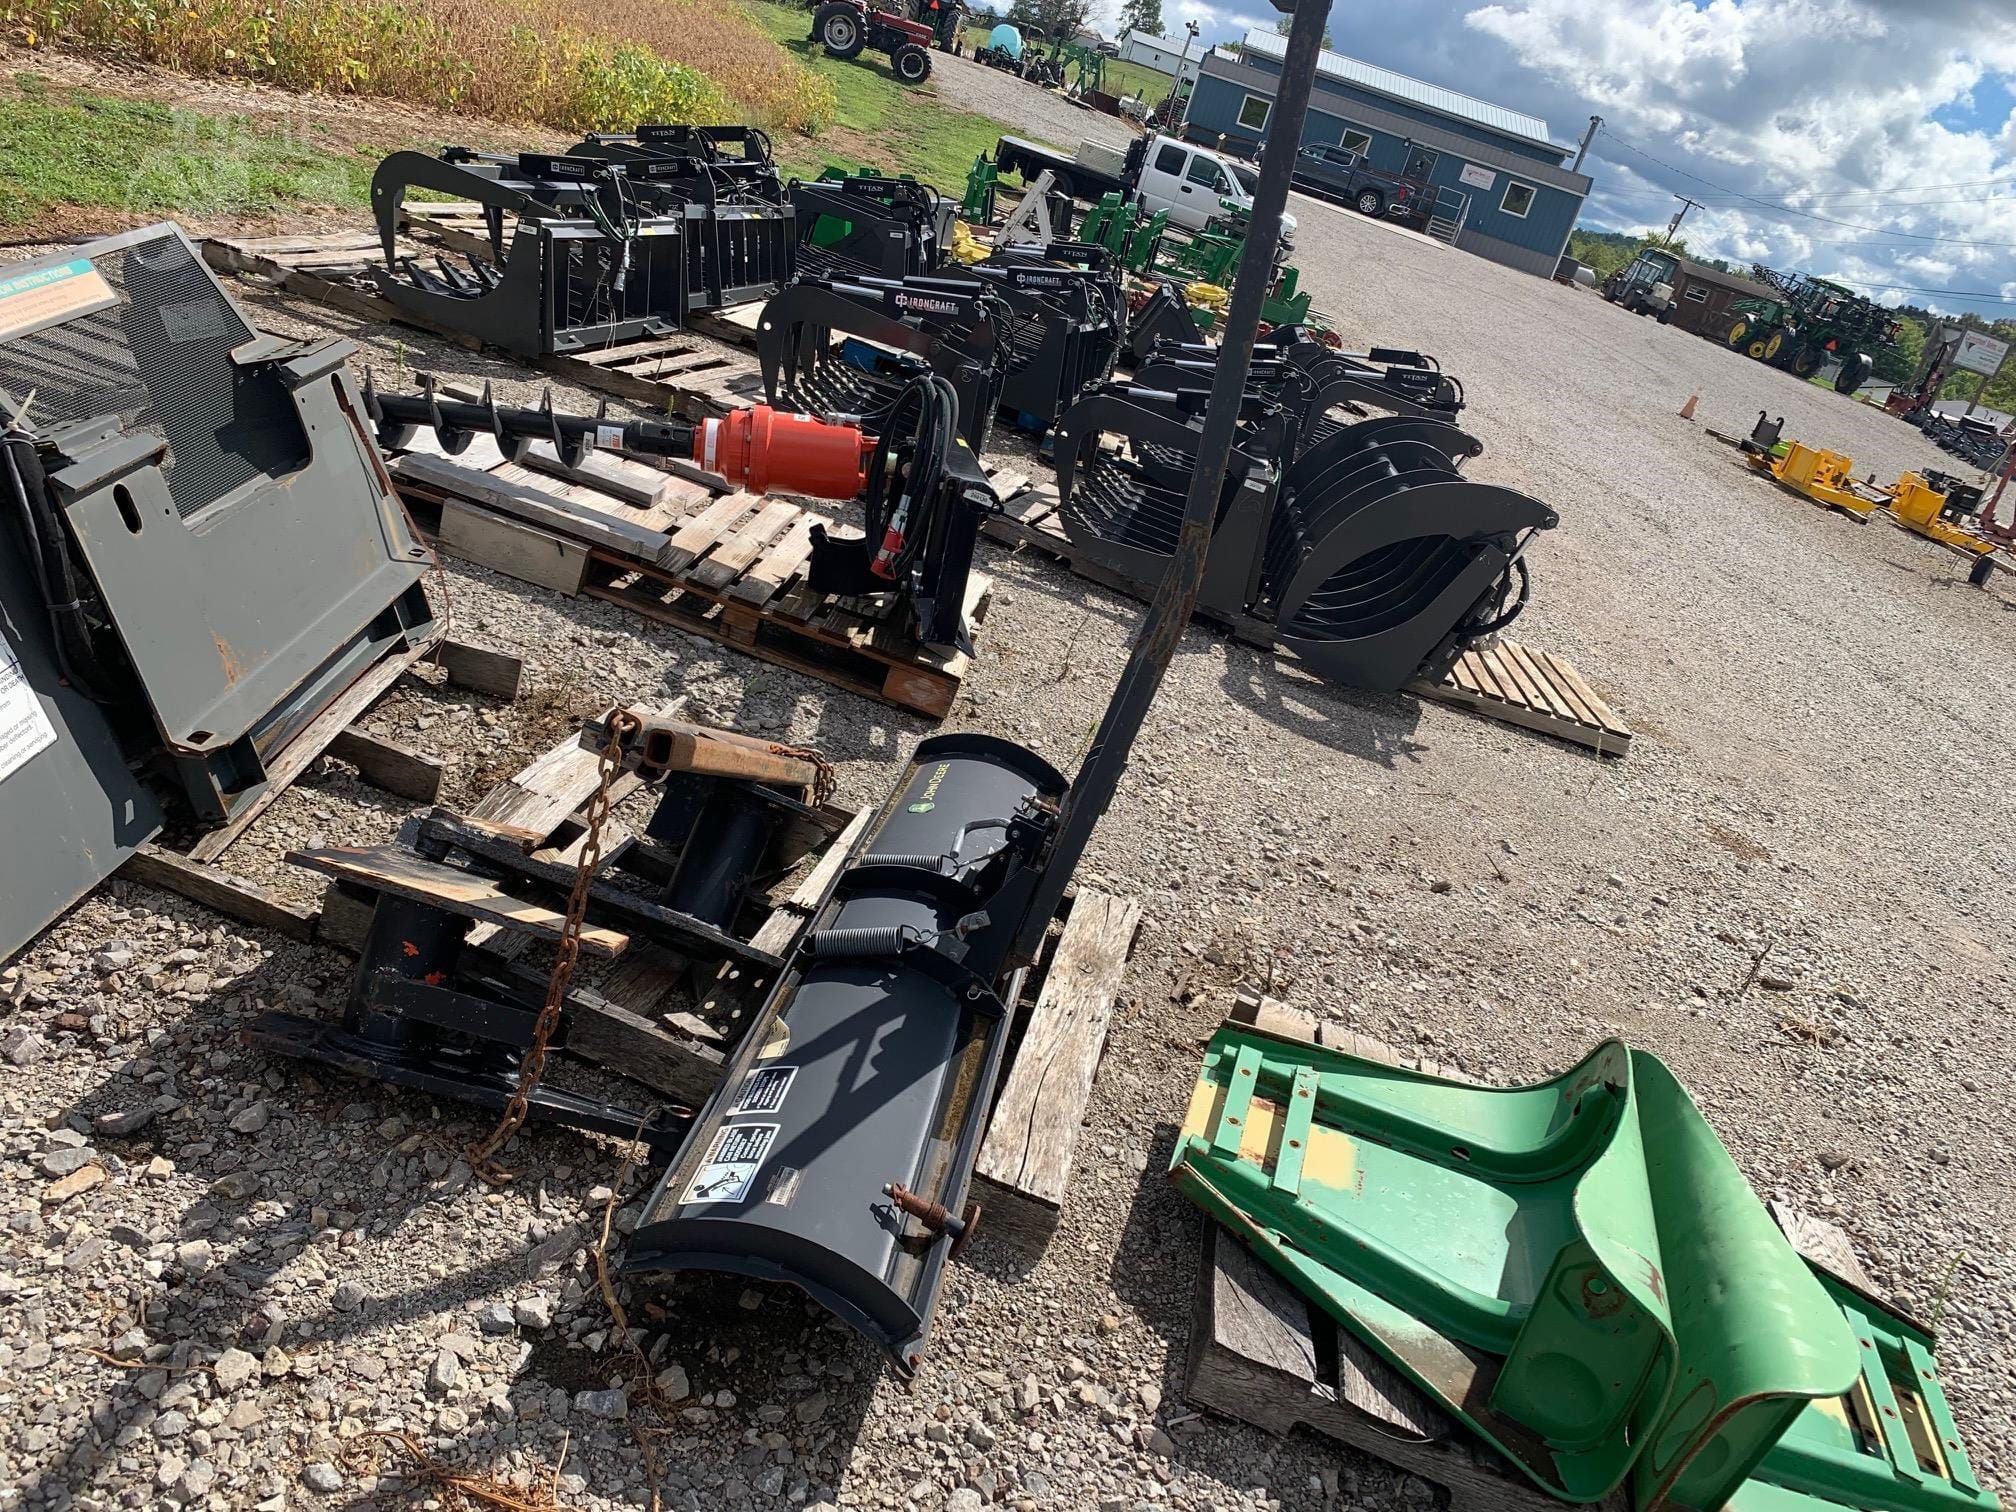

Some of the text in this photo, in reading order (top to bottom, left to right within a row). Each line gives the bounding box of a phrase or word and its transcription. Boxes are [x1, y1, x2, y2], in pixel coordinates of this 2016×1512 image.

[1062, 249, 1088, 258] TITAN
[1026, 275, 1060, 284] IRONCRAFT
[909, 296, 956, 312] IRONCRAFT
[920, 763, 950, 800] JOHN DEERE
